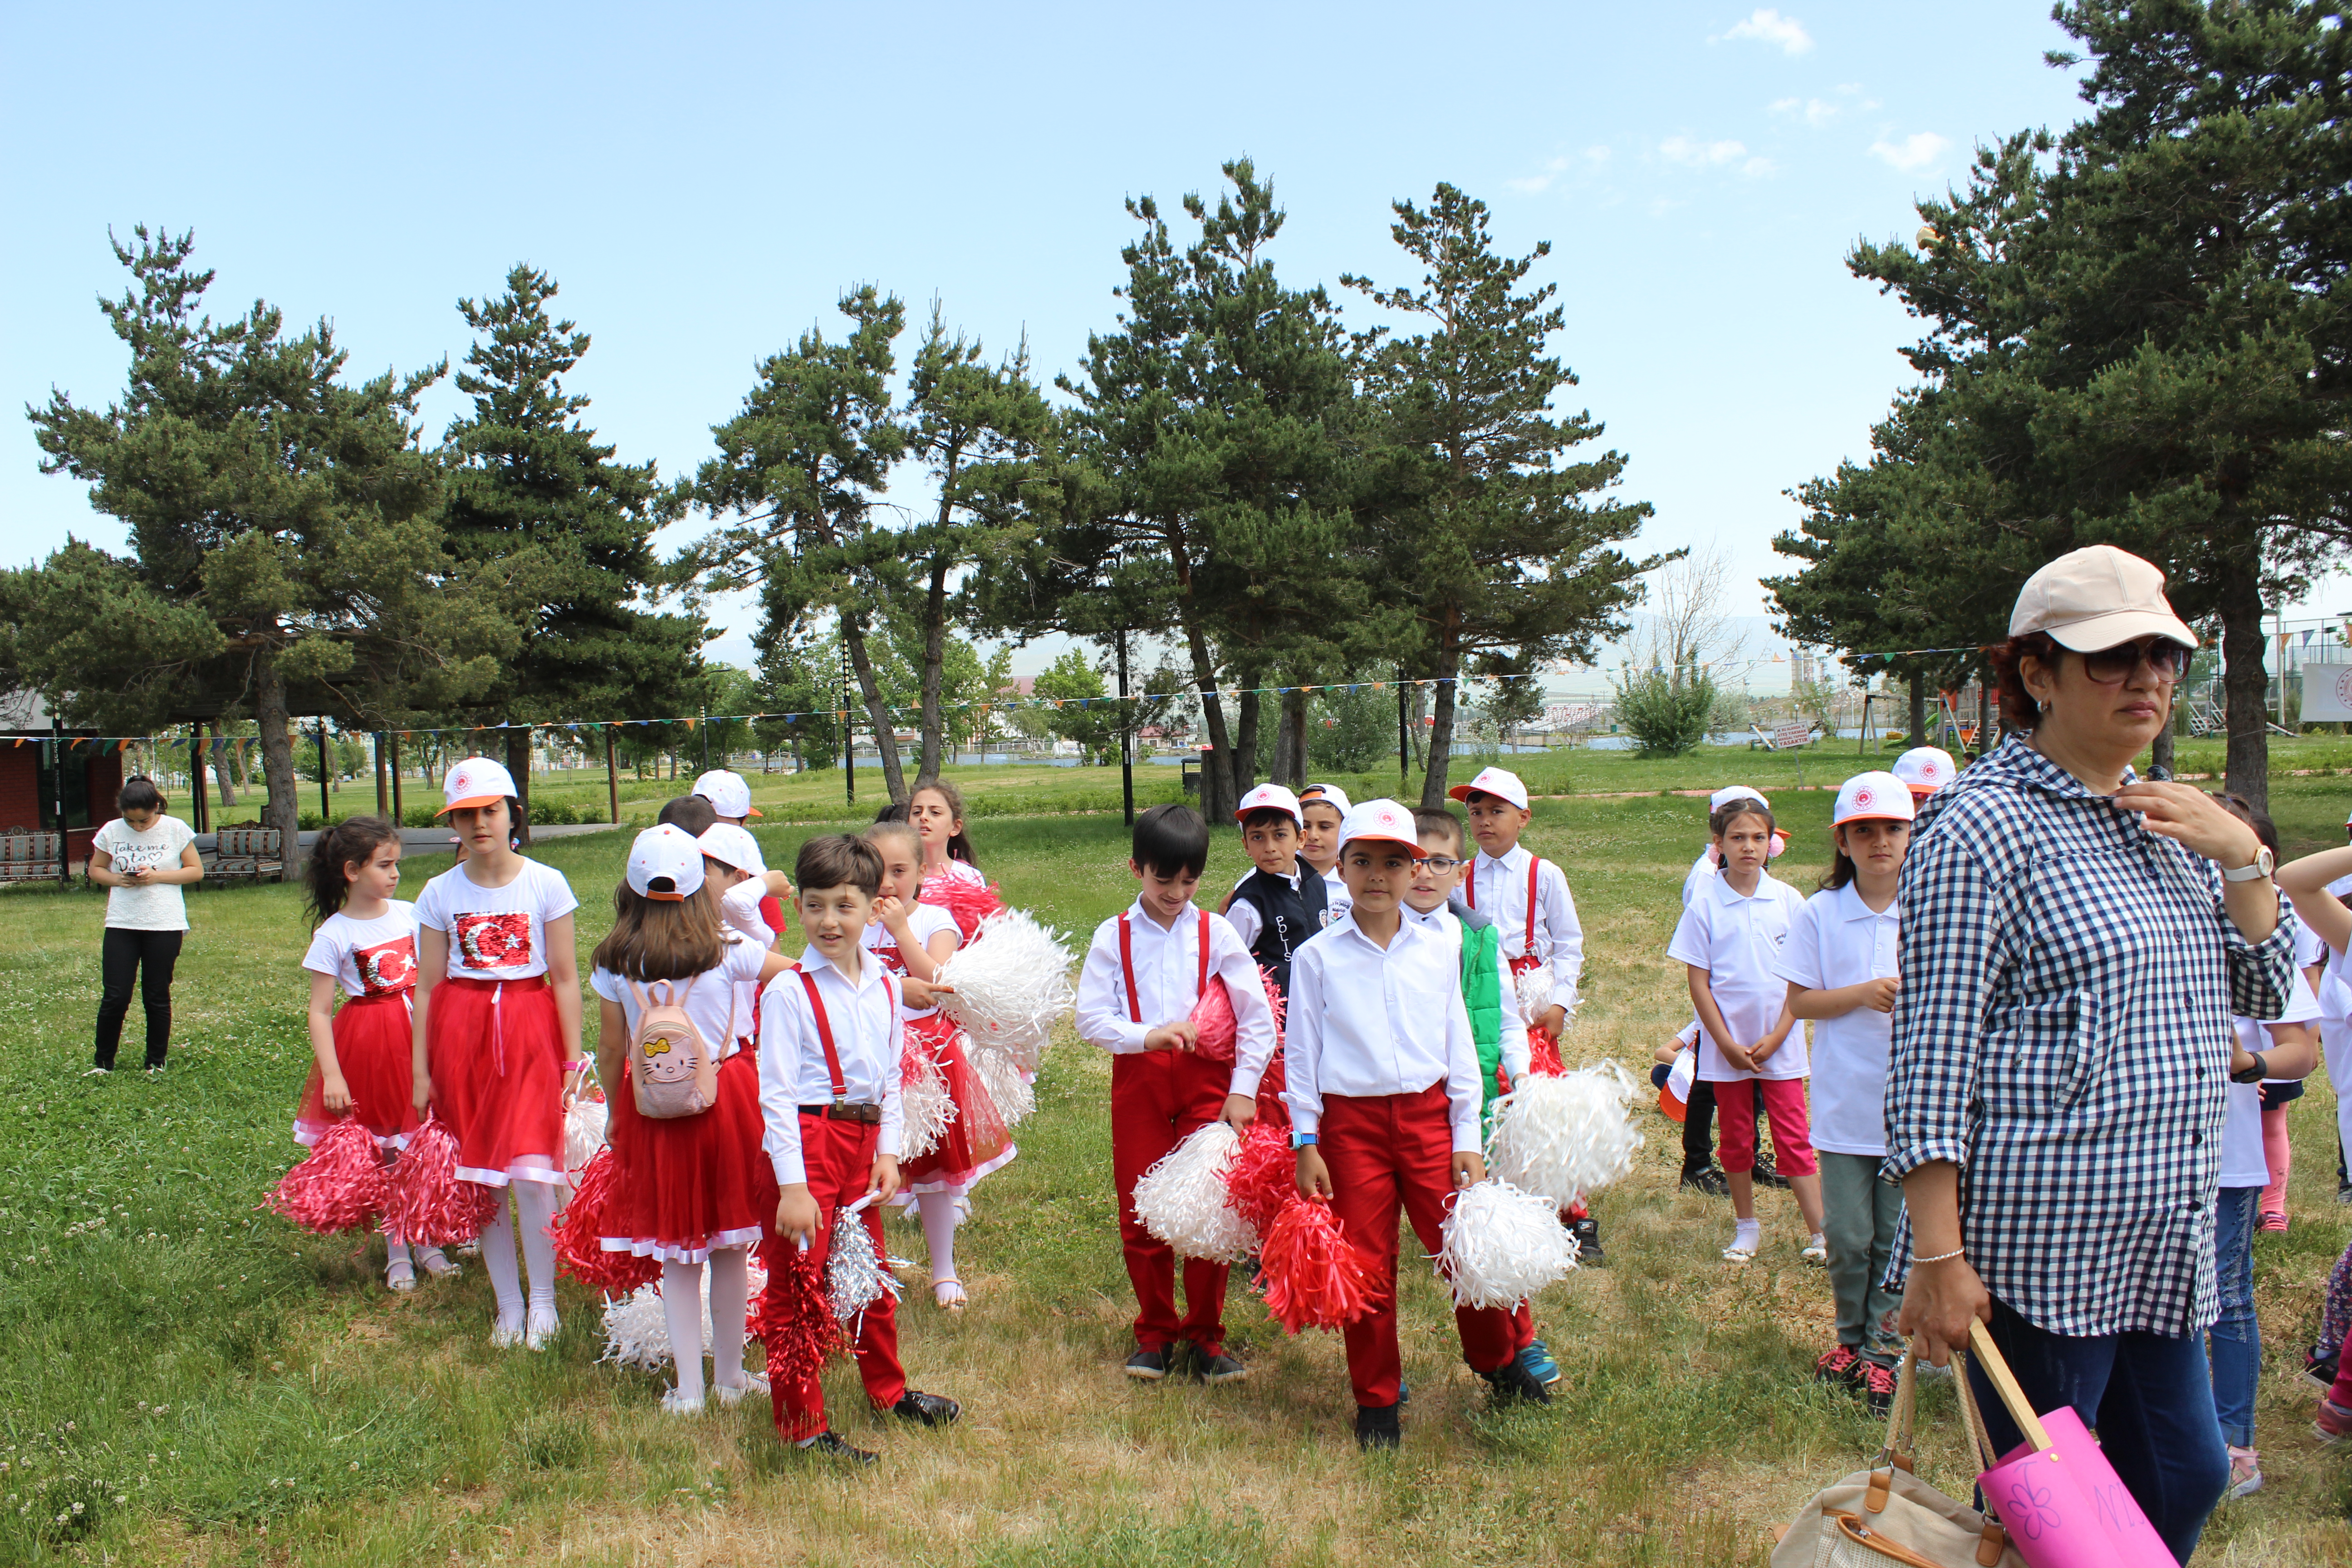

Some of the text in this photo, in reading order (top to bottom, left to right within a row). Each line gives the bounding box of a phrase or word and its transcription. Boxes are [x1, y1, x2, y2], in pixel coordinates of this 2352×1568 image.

[1779, 738, 1808, 746] YASAKTIR
[113, 841, 145, 854] Take
[130, 853, 147, 863] to
[1275, 916, 1292, 962] POLİS
